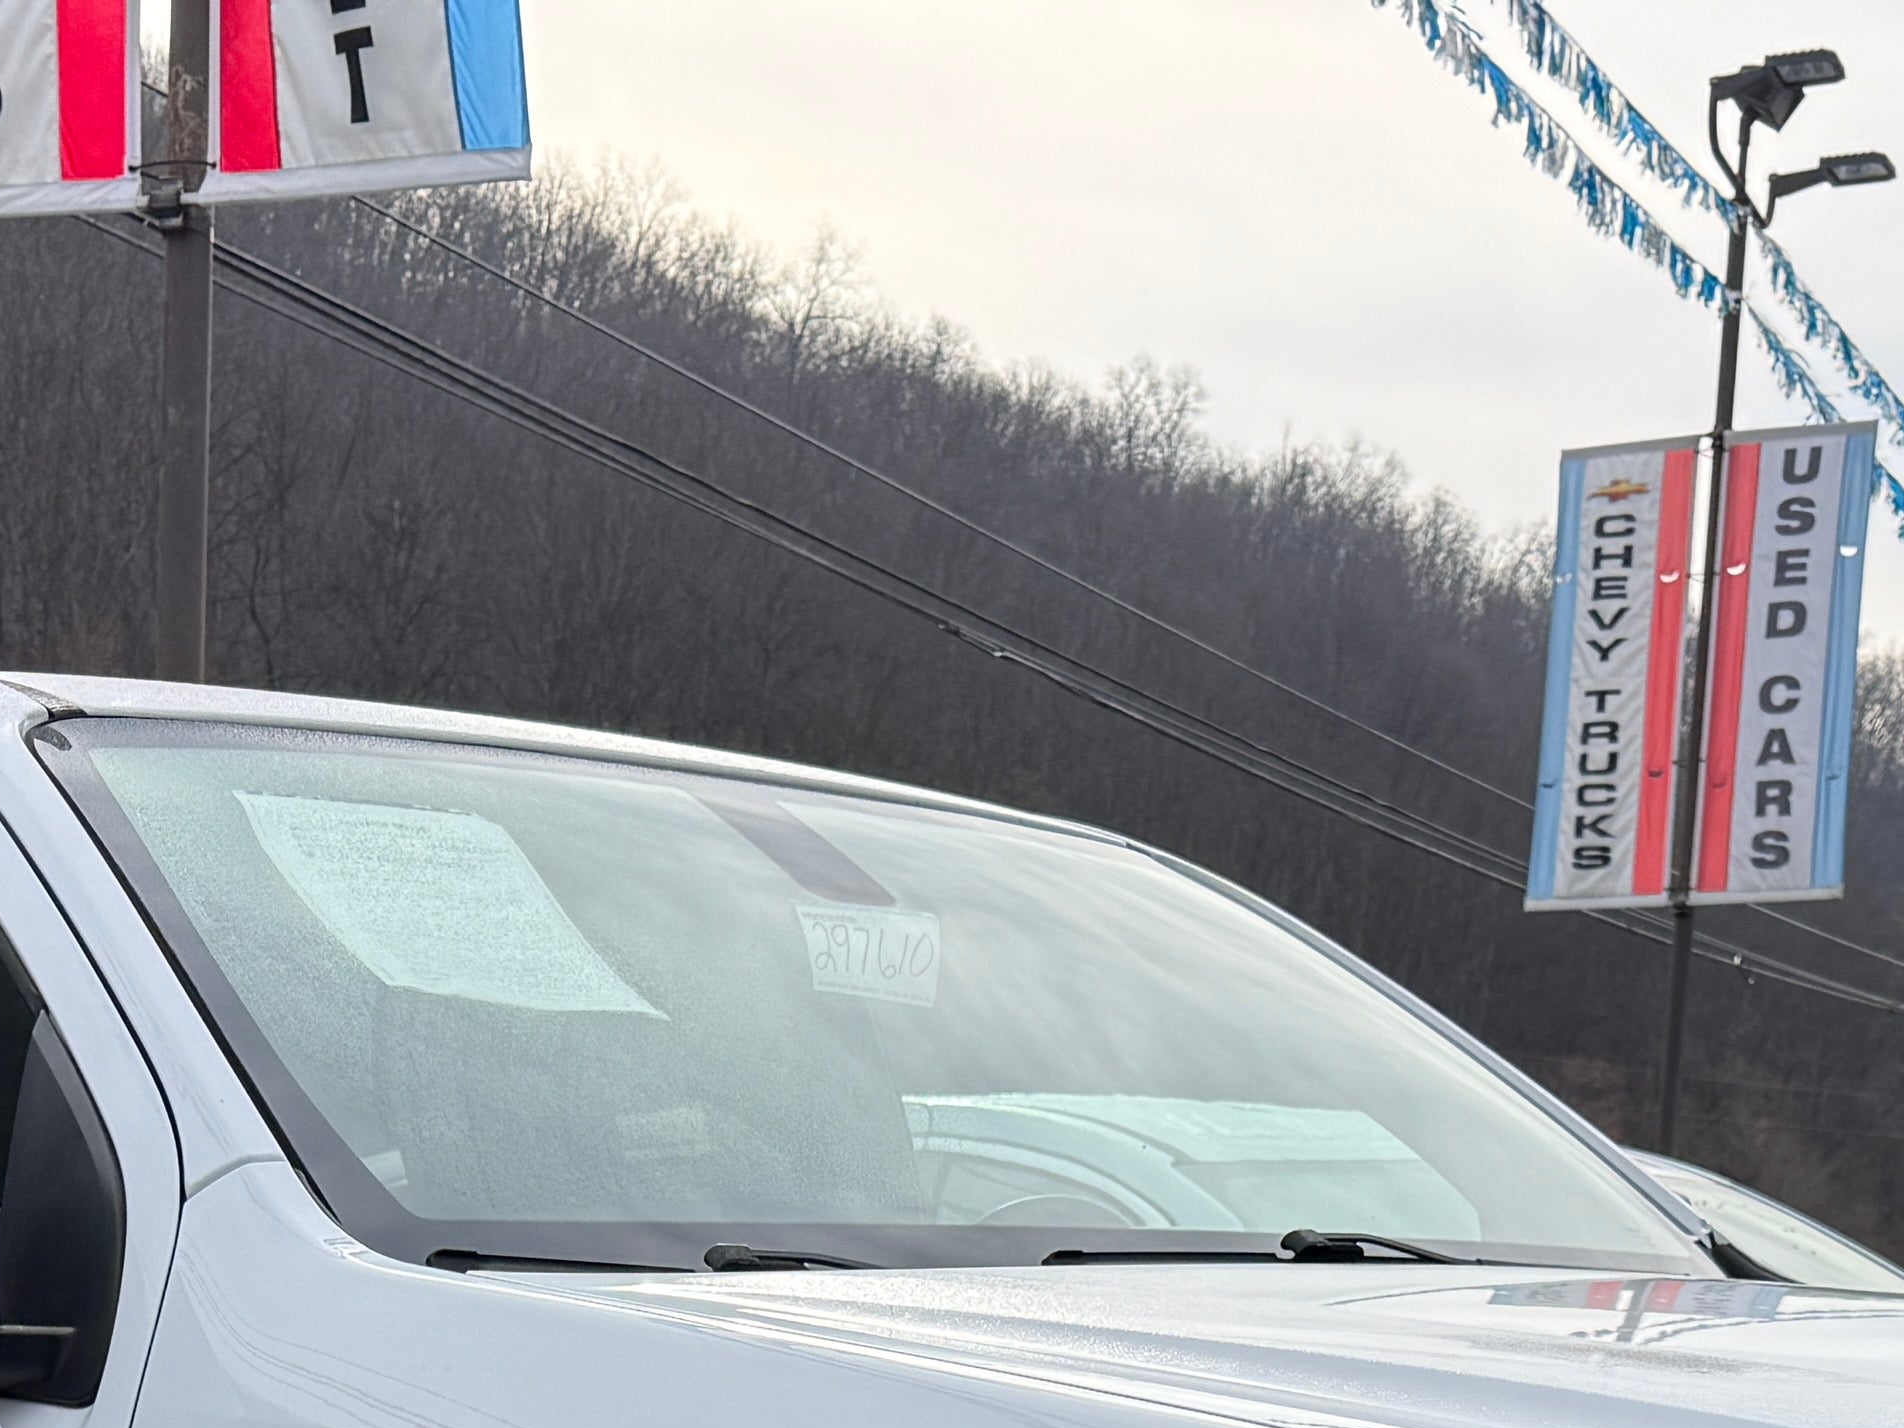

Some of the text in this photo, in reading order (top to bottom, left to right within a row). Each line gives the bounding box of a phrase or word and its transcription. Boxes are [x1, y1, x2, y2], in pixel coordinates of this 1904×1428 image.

[1571, 514, 1636, 871] CHEVY TRUCKS
[1748, 446, 1823, 870] USED CARS
